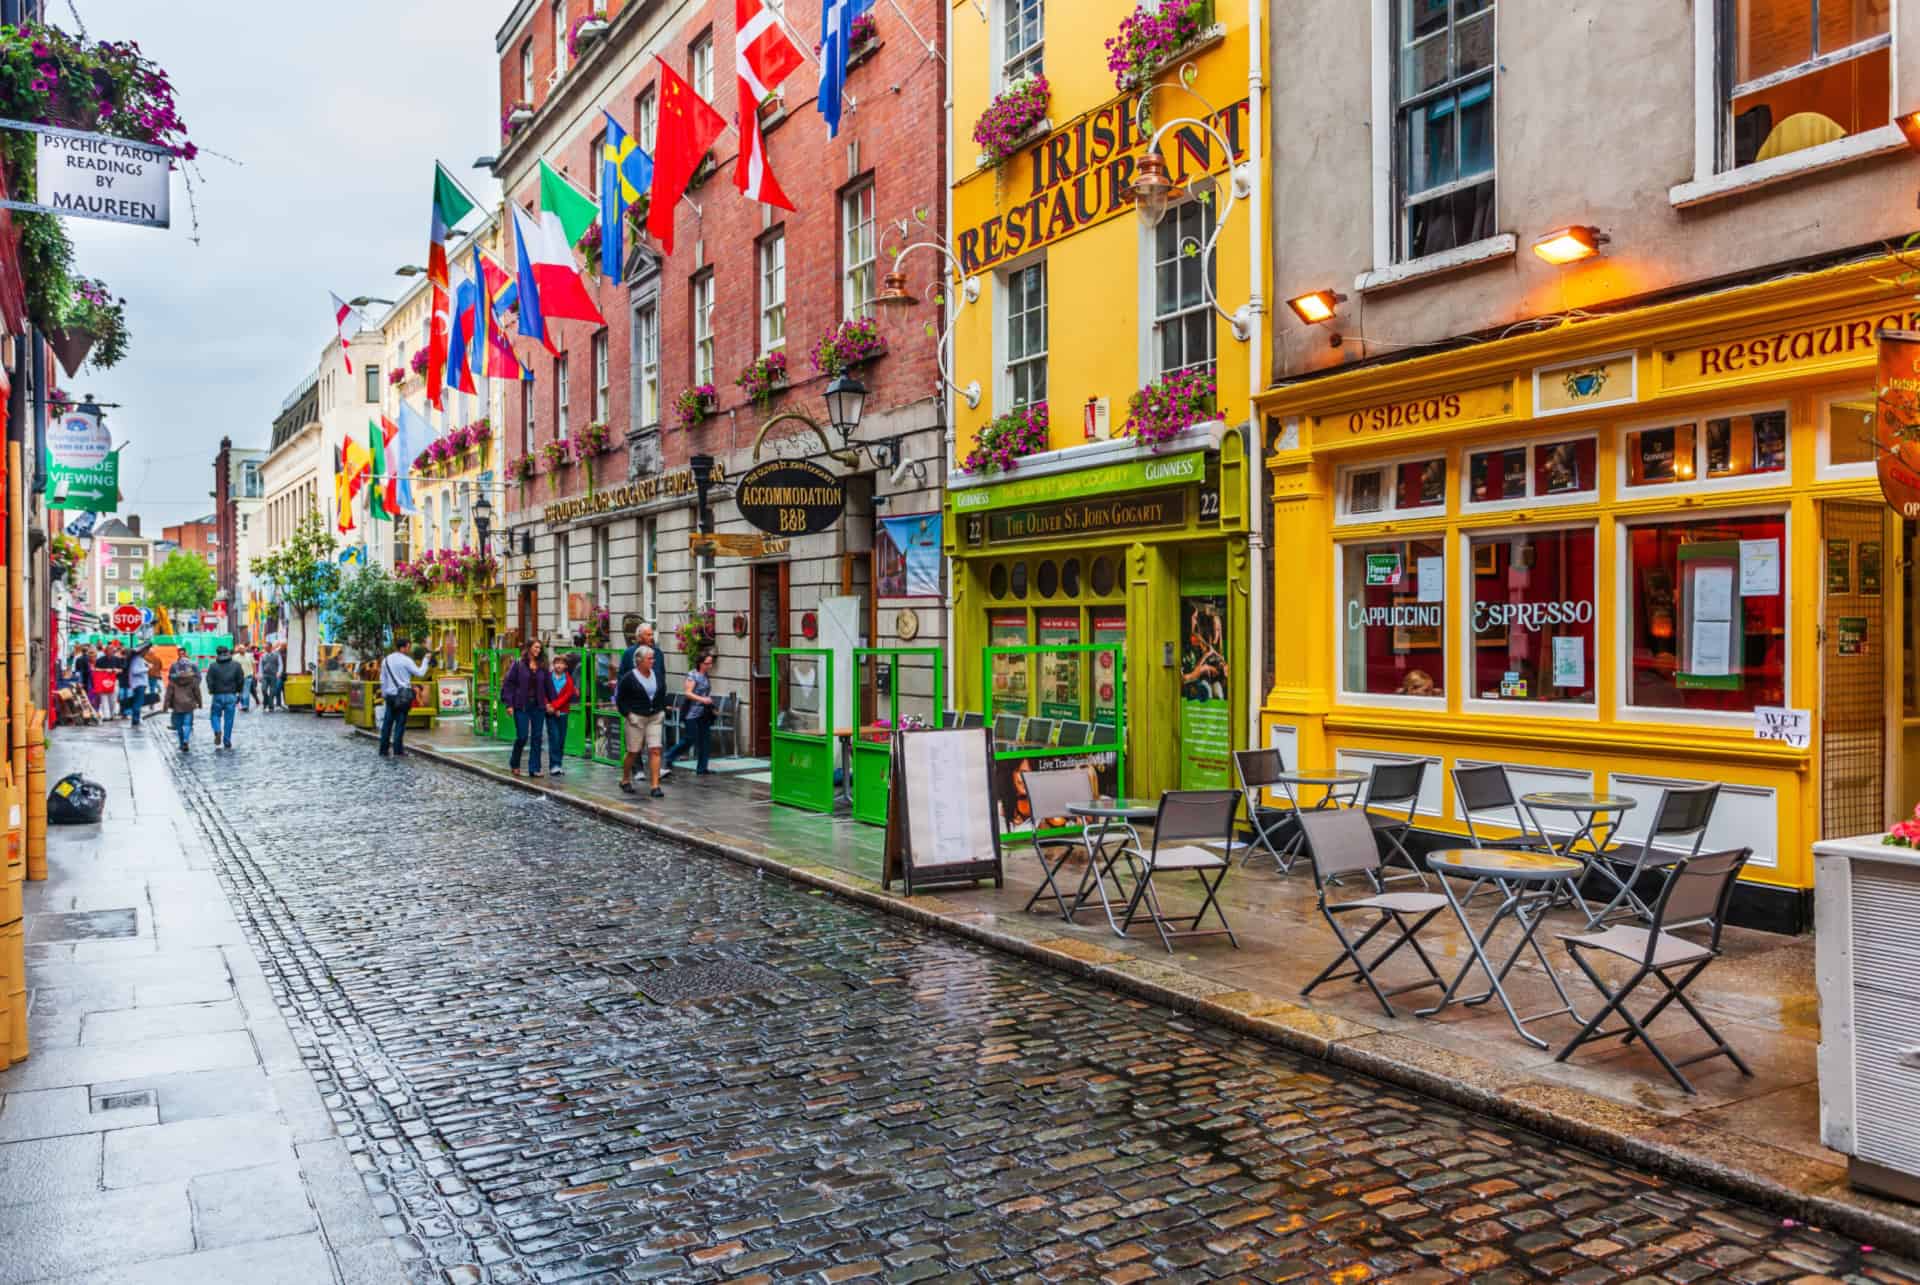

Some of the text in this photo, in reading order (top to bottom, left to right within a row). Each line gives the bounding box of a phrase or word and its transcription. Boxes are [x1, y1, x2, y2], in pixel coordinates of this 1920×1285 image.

[44, 135, 161, 164] PSYCHIC TAROT
[1030, 91, 1149, 197] IRISH
[67, 155, 143, 176] READINGS
[96, 175, 115, 188] BY
[53, 192, 156, 219] MAUREEN
[50, 471, 115, 487] VIEWING
[1145, 459, 1193, 480] GUINNESS
[743, 487, 841, 505] ACCOMMODATION
[1201, 492, 1219, 515] 22
[779, 508, 807, 531] B&B
[1027, 510, 1062, 533] OLIVER
[1081, 505, 1110, 529] JOHN
[1111, 502, 1163, 526] GOGARTY
[969, 521, 981, 539] 22
[114, 613, 141, 624] STOP
[1347, 600, 1593, 632] CAPPUCCINO ESPRESSO
[1764, 713, 1804, 727] WET
